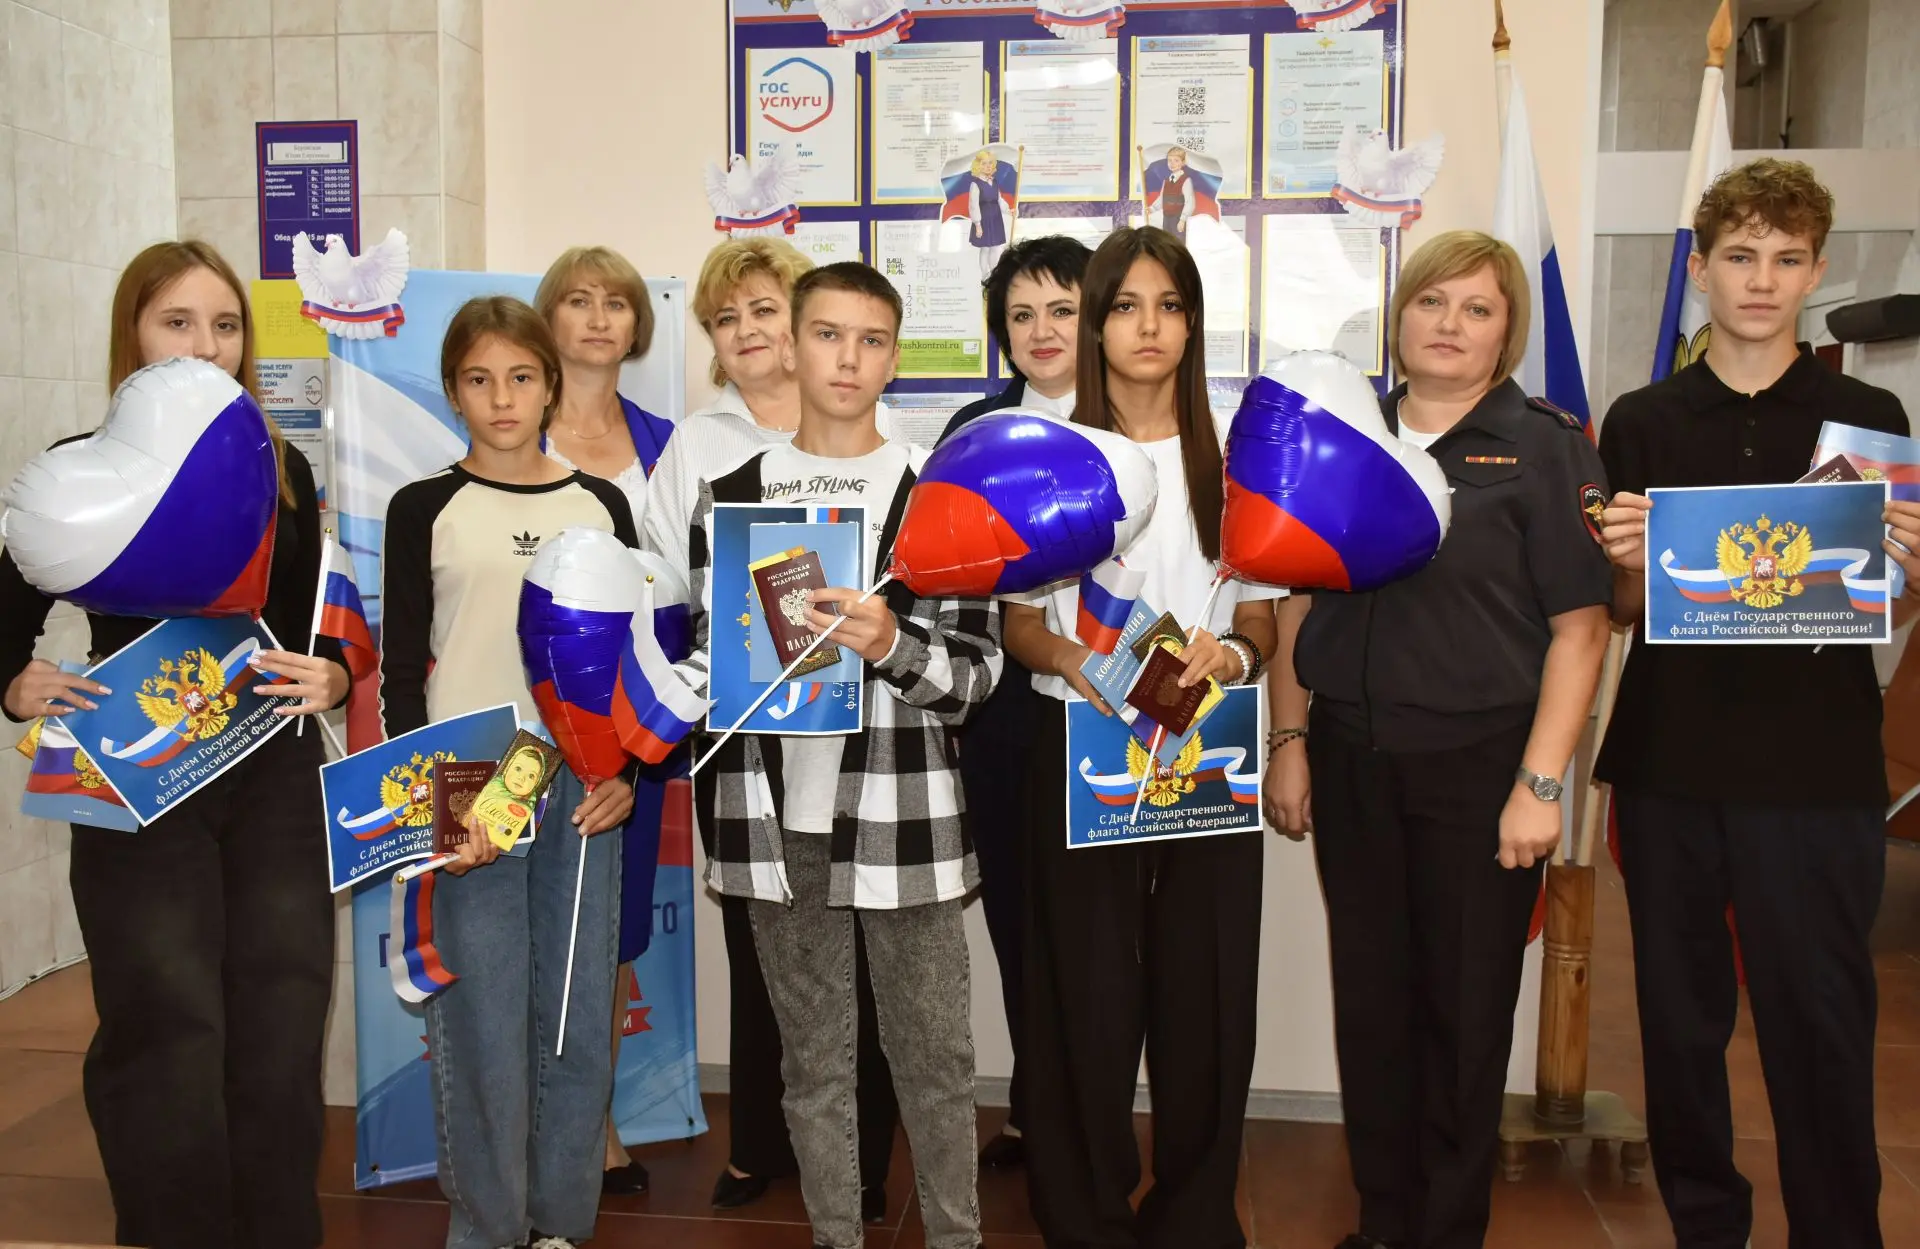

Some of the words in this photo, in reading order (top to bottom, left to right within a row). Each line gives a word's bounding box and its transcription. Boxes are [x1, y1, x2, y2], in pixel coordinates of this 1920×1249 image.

[760, 82, 789, 93] гос
[760, 96, 822, 110] услуги
[275, 233, 291, 241] Обед
[905, 295, 913, 306] 2
[905, 307, 913, 318] 3
[804, 476, 870, 494] STYLING
[767, 563, 811, 581] РОССИЙСКАЯ
[771, 571, 810, 587] ФЕДЕРАЦИЯ
[1683, 611, 1692, 622] С
[1695, 611, 1729, 623] Днём
[1733, 611, 1854, 623] Государственного
[1670, 624, 1708, 637] флага
[1712, 623, 1788, 635] Российской
[1792, 622, 1873, 636] Федерации!
[1095, 611, 1146, 681] КОНСТИТУЦИЯ
[832, 690, 843, 698] С
[158, 776, 169, 786] С
[168, 756, 199, 781] Днём
[198, 695, 283, 759] Государственног
[156, 778, 190, 806] флага
[189, 734, 252, 782] Российской
[444, 769, 486, 777] РОССИЙСКАЯ
[1099, 814, 1107, 825] С
[1140, 804, 1235, 821] Государственного
[1087, 828, 1120, 840] флага
[1122, 820, 1184, 835] Российской
[1186, 813, 1249, 828] Федерации!
[359, 849, 367, 860] С
[369, 838, 396, 857] Днём
[399, 827, 433, 843] Госуд
[349, 857, 380, 877] флага
[382, 840, 433, 861] Российск
